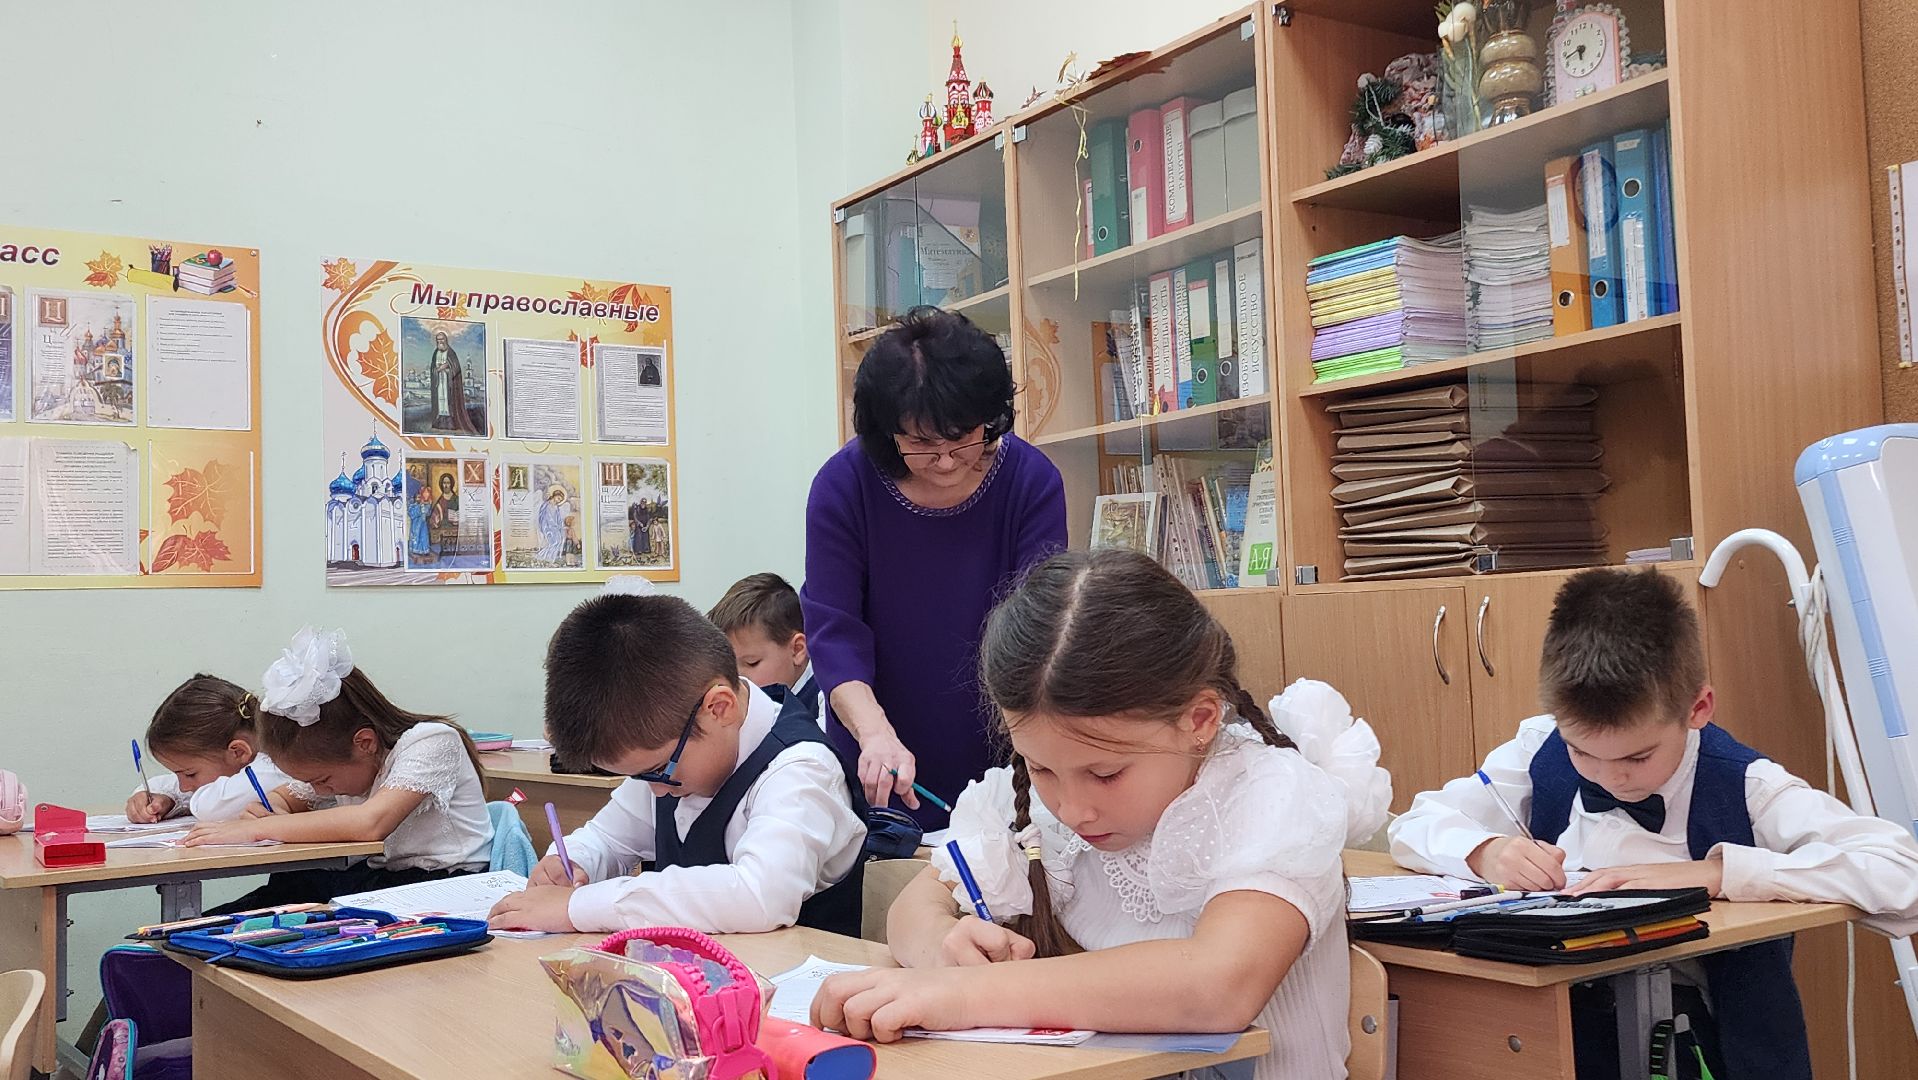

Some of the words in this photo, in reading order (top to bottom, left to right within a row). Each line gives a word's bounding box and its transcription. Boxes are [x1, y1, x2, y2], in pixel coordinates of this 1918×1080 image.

[1165, 123, 1176, 215] КОМПЛЕКСНЫЕ
[1177, 141, 1185, 190] РАБОТЫ
[410, 282, 458, 307] Мы
[466, 292, 660, 322] православные
[1151, 294, 1161, 376] ВНЕУРОЧНАЯ
[1160, 284, 1172, 379] ДЕЯТЕЛЬНОСТЬ
[1238, 273, 1249, 397] ИЗОБРАЗИТЕЛЬНОЕ
[1250, 293, 1260, 373] ИСКУССТВО
[1249, 546, 1272, 571] А-Я
